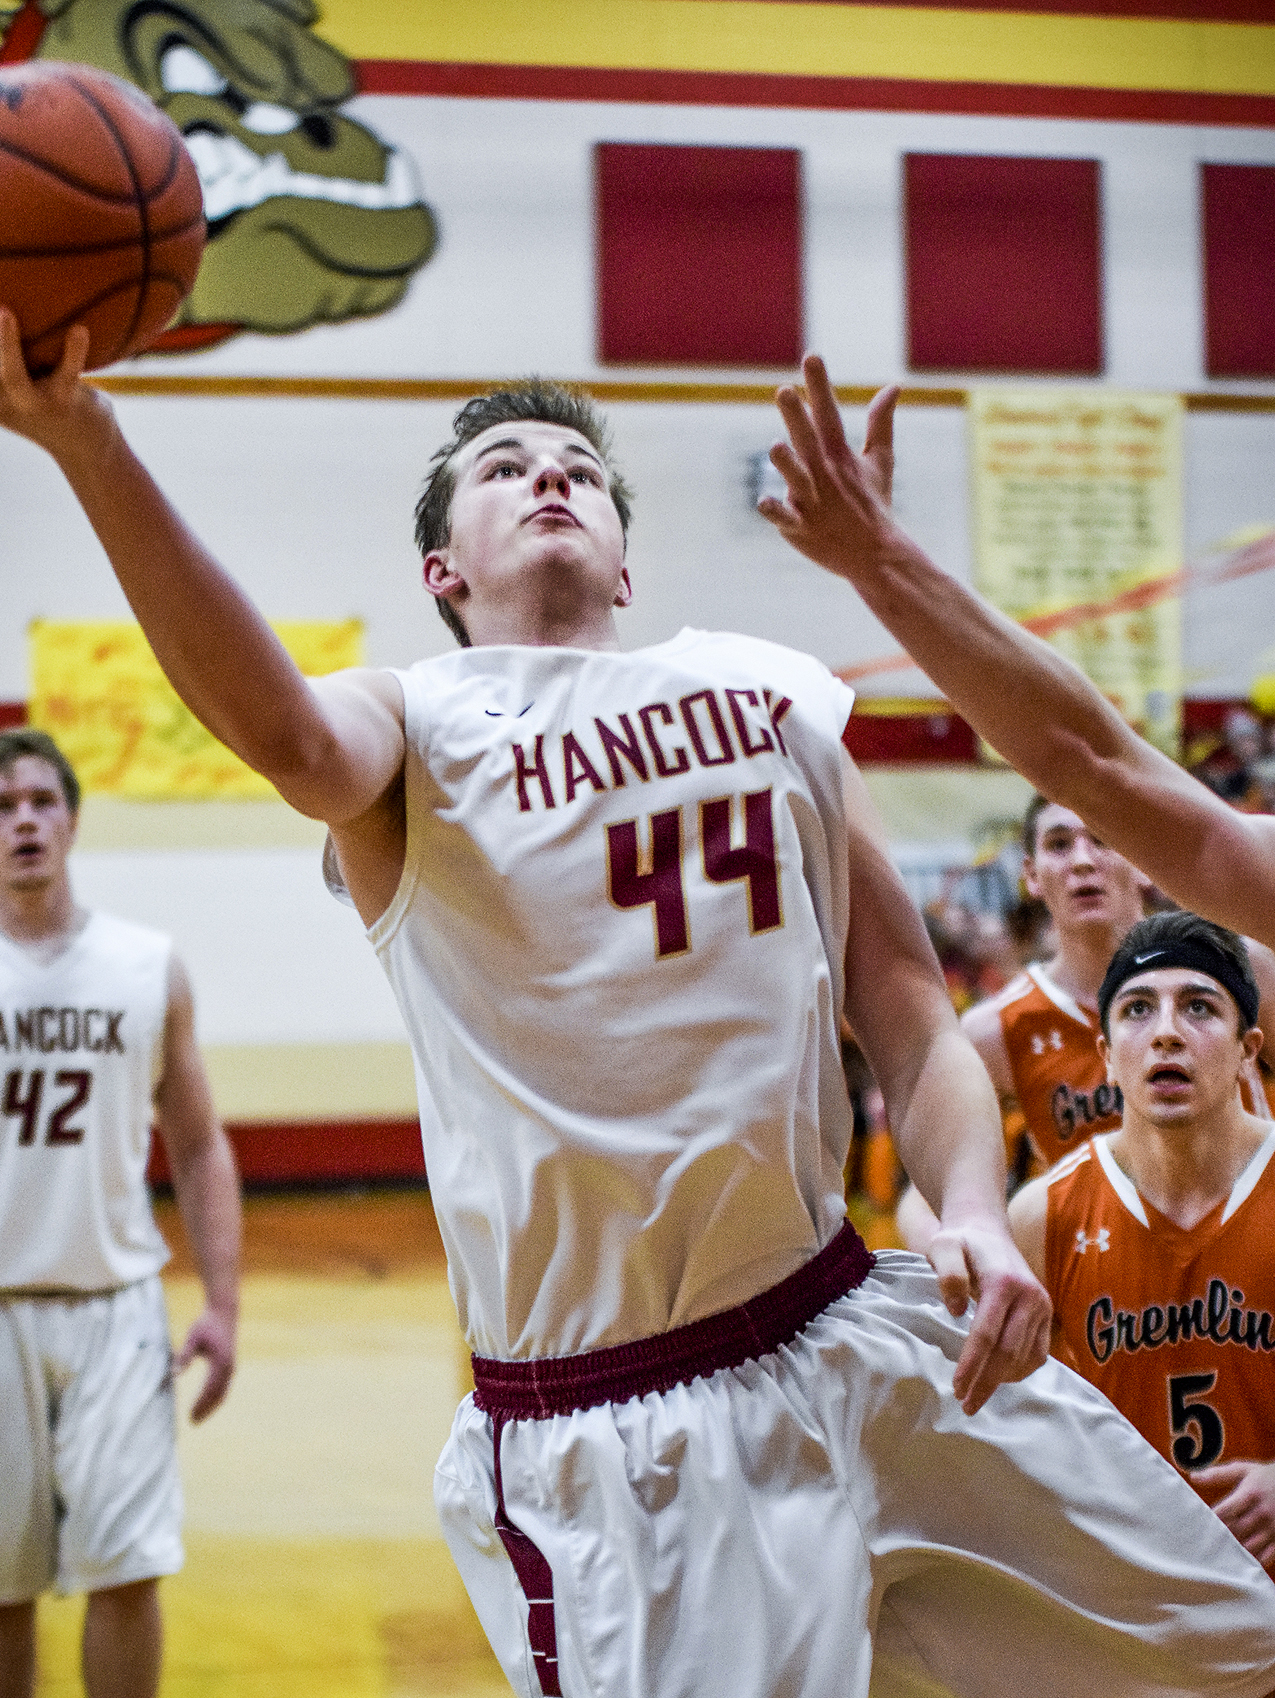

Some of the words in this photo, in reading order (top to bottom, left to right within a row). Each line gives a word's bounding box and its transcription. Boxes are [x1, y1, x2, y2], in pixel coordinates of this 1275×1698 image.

[511, 685, 793, 813] HANCOCK
[604, 783, 785, 962] 44
[2, 1067, 93, 1146] 42
[1050, 1082, 1124, 1141] Gre
[1086, 1276, 1275, 1366] Gremlin
[1166, 1369, 1225, 1474] 5
